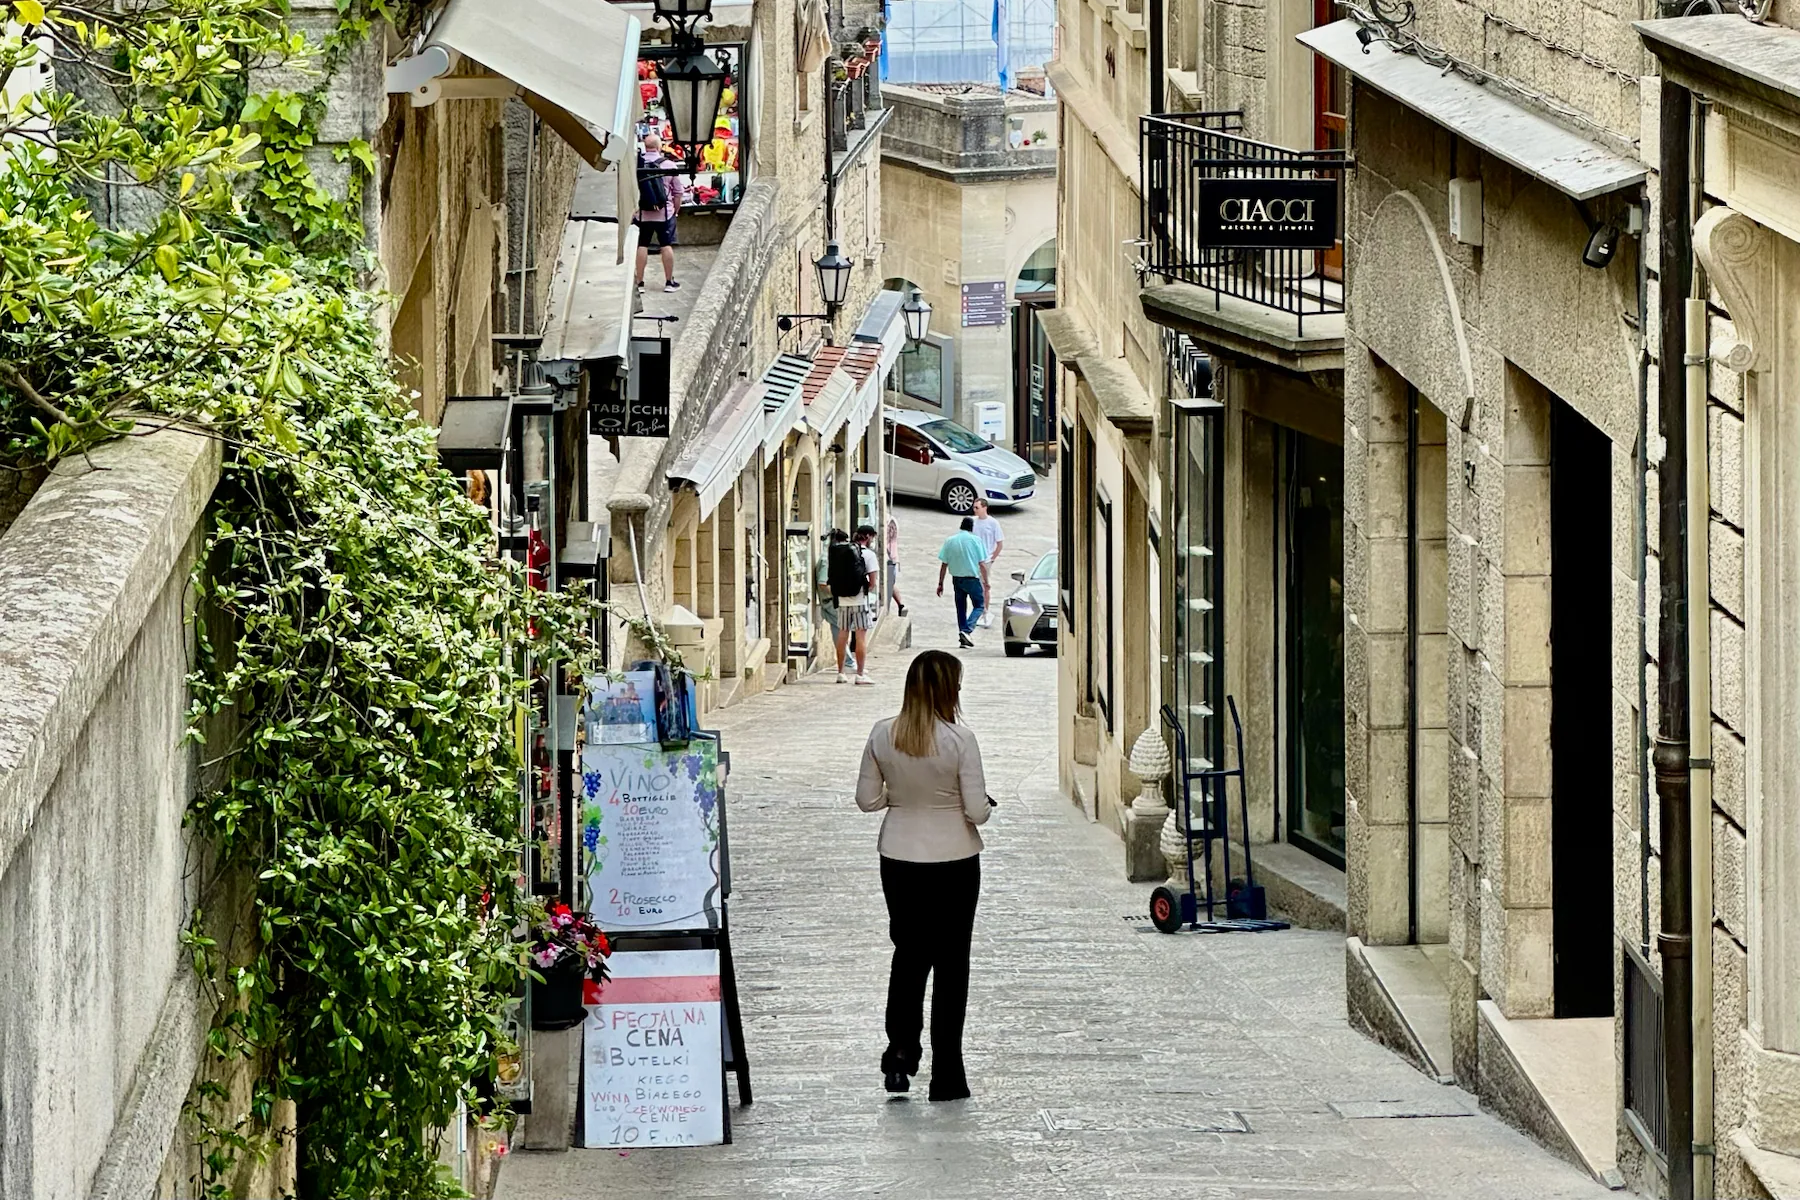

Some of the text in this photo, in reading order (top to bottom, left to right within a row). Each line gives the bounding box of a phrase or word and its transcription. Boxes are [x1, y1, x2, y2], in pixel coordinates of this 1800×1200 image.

[1219, 198, 1315, 222] CIACCI
[631, 418, 666, 435] Ray-Ban
[609, 789, 620, 806] 4
[623, 804, 669, 815] 10 EURO
[609, 887, 621, 904] 2
[617, 905, 663, 917] 10 EURO
[594, 1005, 707, 1031] SPECJALNA
[626, 1028, 684, 1047] CENA
[638, 1113, 688, 1124] CENIE
[609, 1124, 640, 1145] 10
